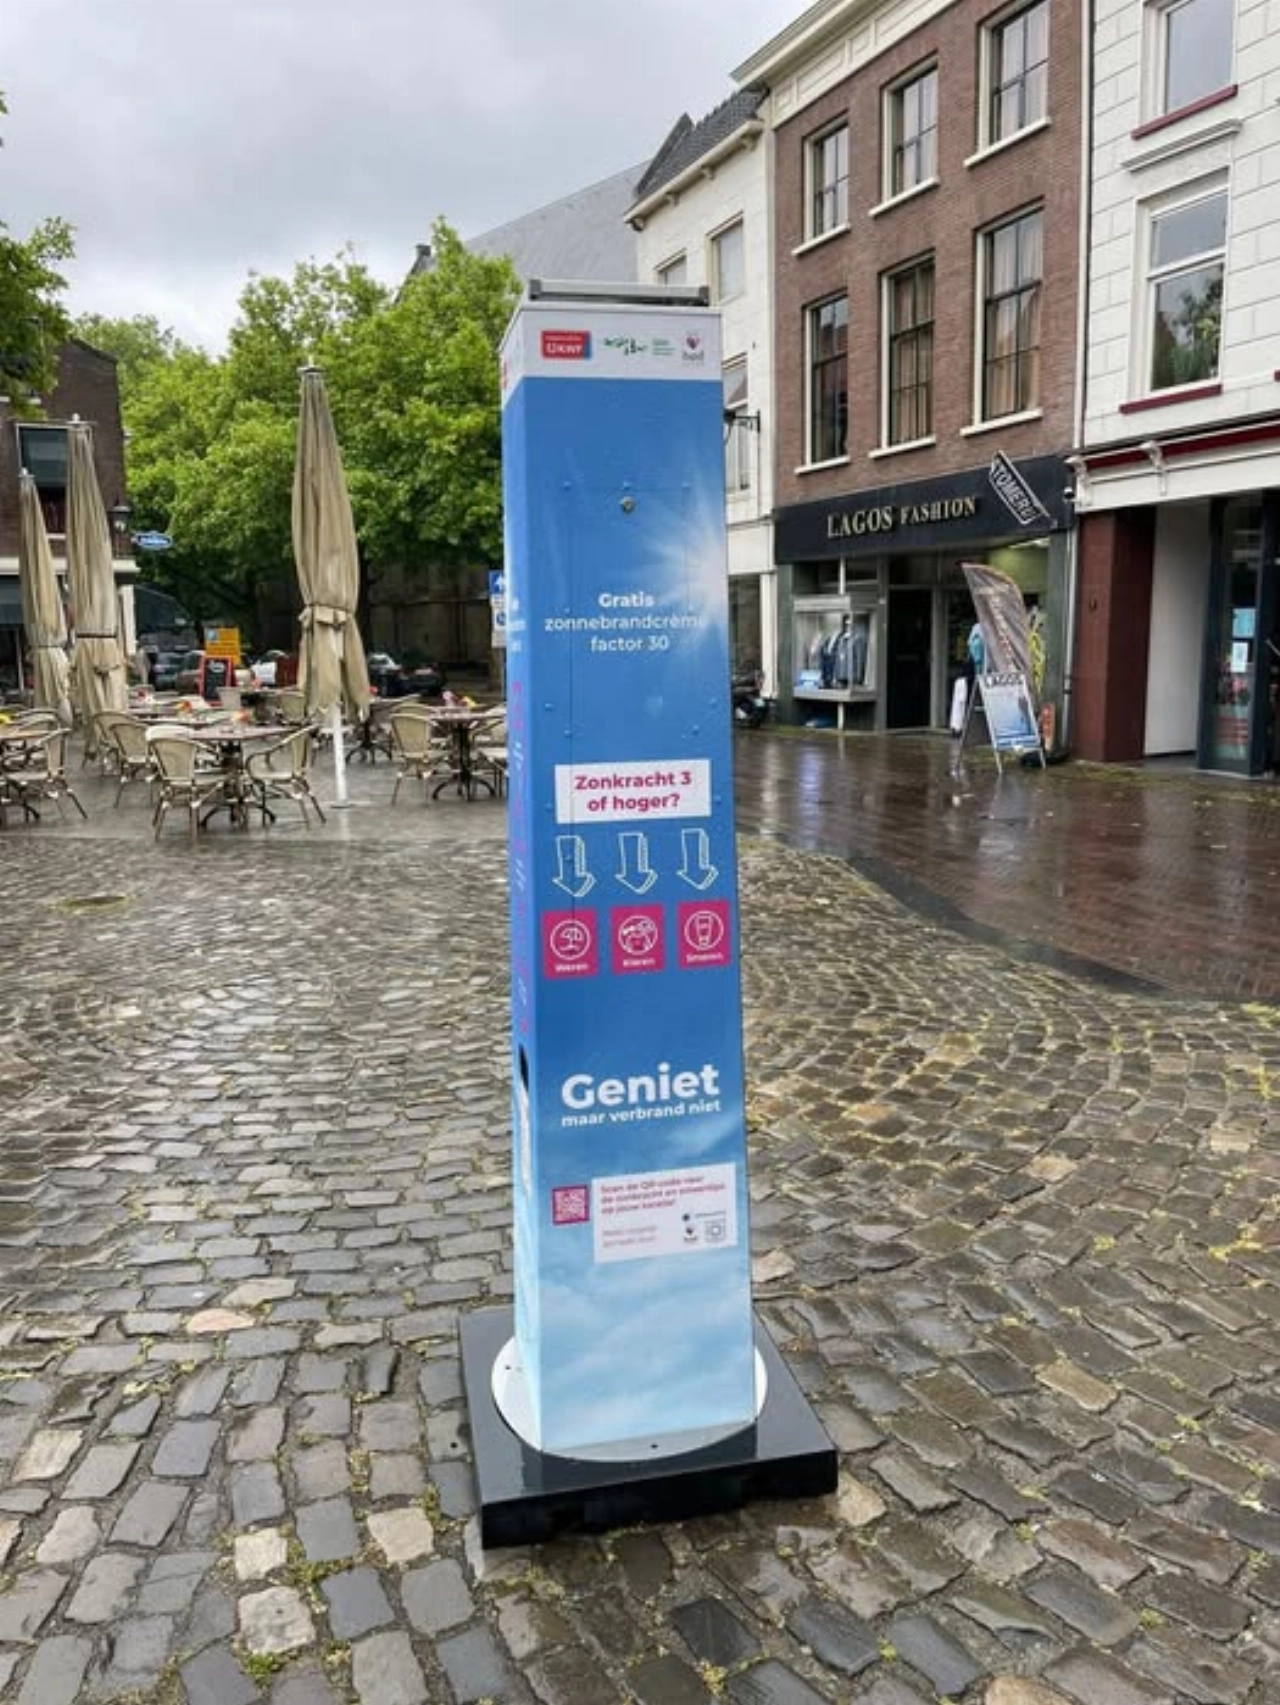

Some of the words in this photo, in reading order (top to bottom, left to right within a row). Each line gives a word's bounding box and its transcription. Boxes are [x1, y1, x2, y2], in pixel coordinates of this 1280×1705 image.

[827, 505, 893, 538] LAGOS
[901, 496, 976, 524] FASHION
[598, 591, 655, 608] Gratis
[590, 635, 643, 652] factor
[649, 635, 669, 650] 30
[574, 773, 675, 790] Zonkracht
[681, 771, 692, 785] 3
[587, 797, 607, 812] of
[613, 793, 680, 813] hoger?
[561, 1062, 720, 1109] Geniet
[561, 1115, 605, 1127] maar
[610, 1102, 685, 1122] verbrand
[689, 1099, 721, 1114] niet
